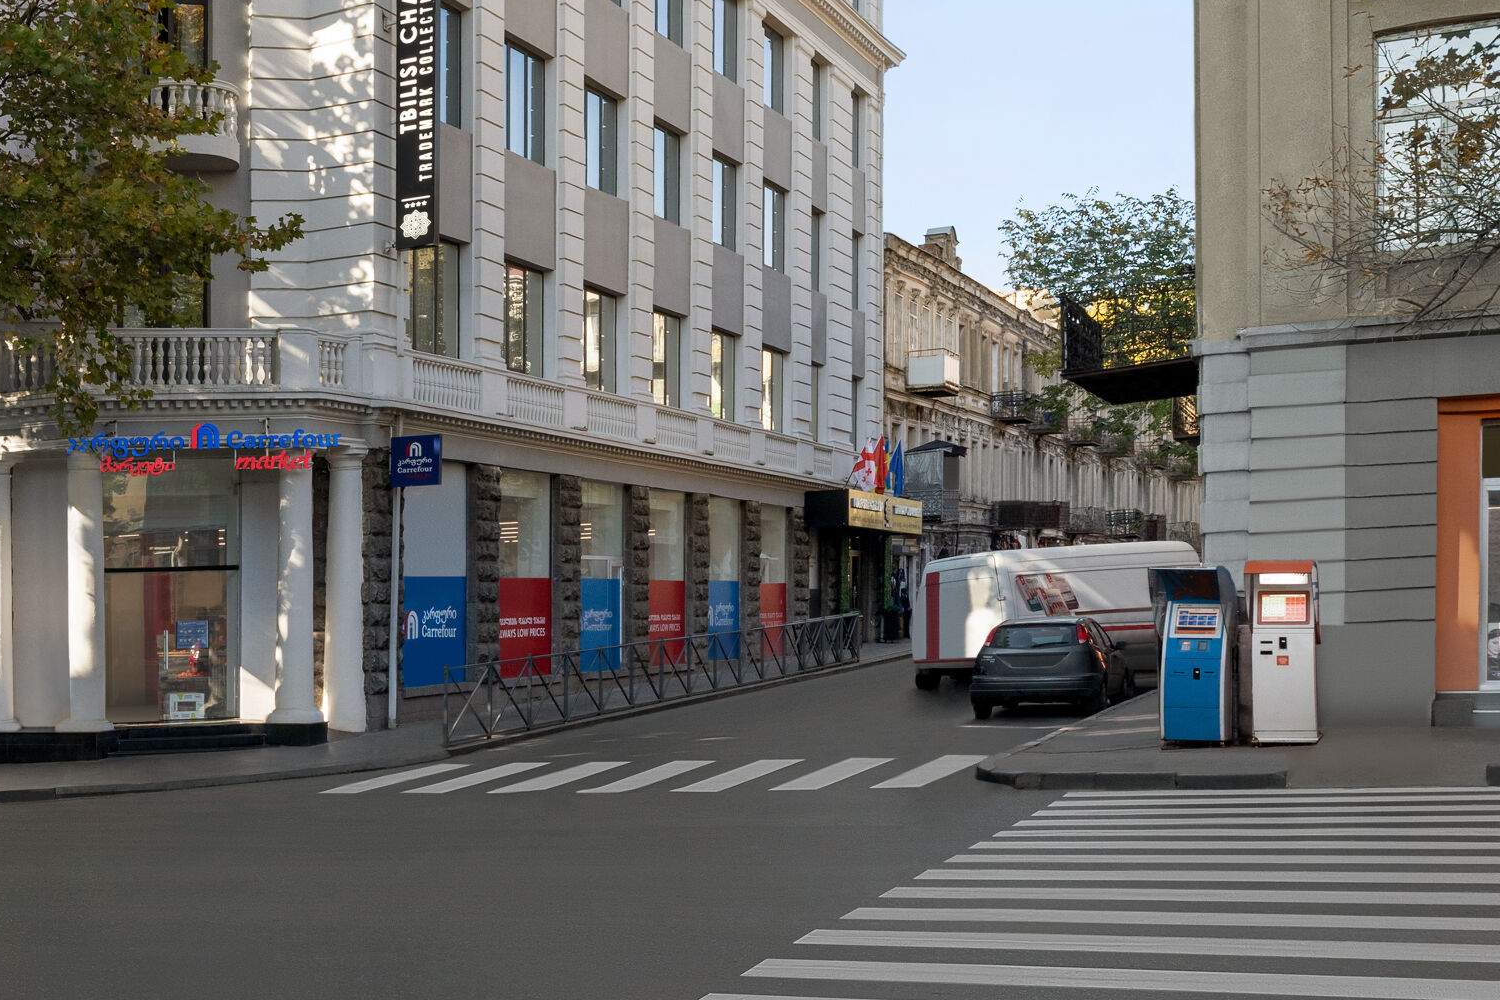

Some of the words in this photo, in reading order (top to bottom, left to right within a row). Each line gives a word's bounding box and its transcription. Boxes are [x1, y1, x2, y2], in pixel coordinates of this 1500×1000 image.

[400, 56, 418, 135] TBILISI
[418, 86, 434, 182] TRADEMARK
[226, 429, 343, 449] Carrefour
[235, 450, 313, 471] market
[397, 465, 433, 474] Carrefour
[421, 625, 457, 638] Carrefour
[517, 628, 529, 638] LOW
[530, 627, 546, 637] PRICES
